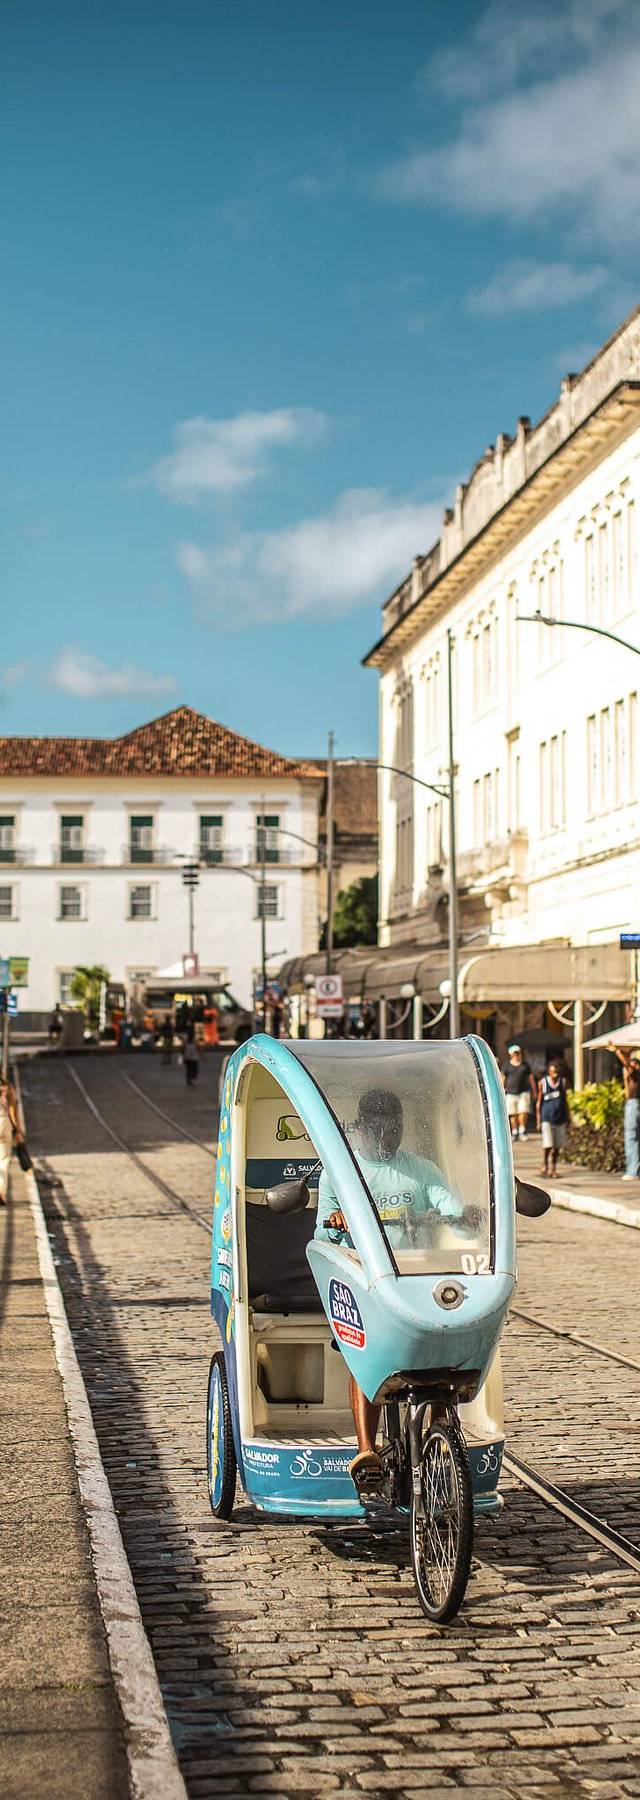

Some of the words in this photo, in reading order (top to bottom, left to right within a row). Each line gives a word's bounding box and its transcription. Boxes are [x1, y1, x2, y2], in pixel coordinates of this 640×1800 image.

[461, 1254, 492, 1274] 02
[332, 1300, 360, 1327] BRAZ
[245, 1448, 280, 1464] SALVADOR
